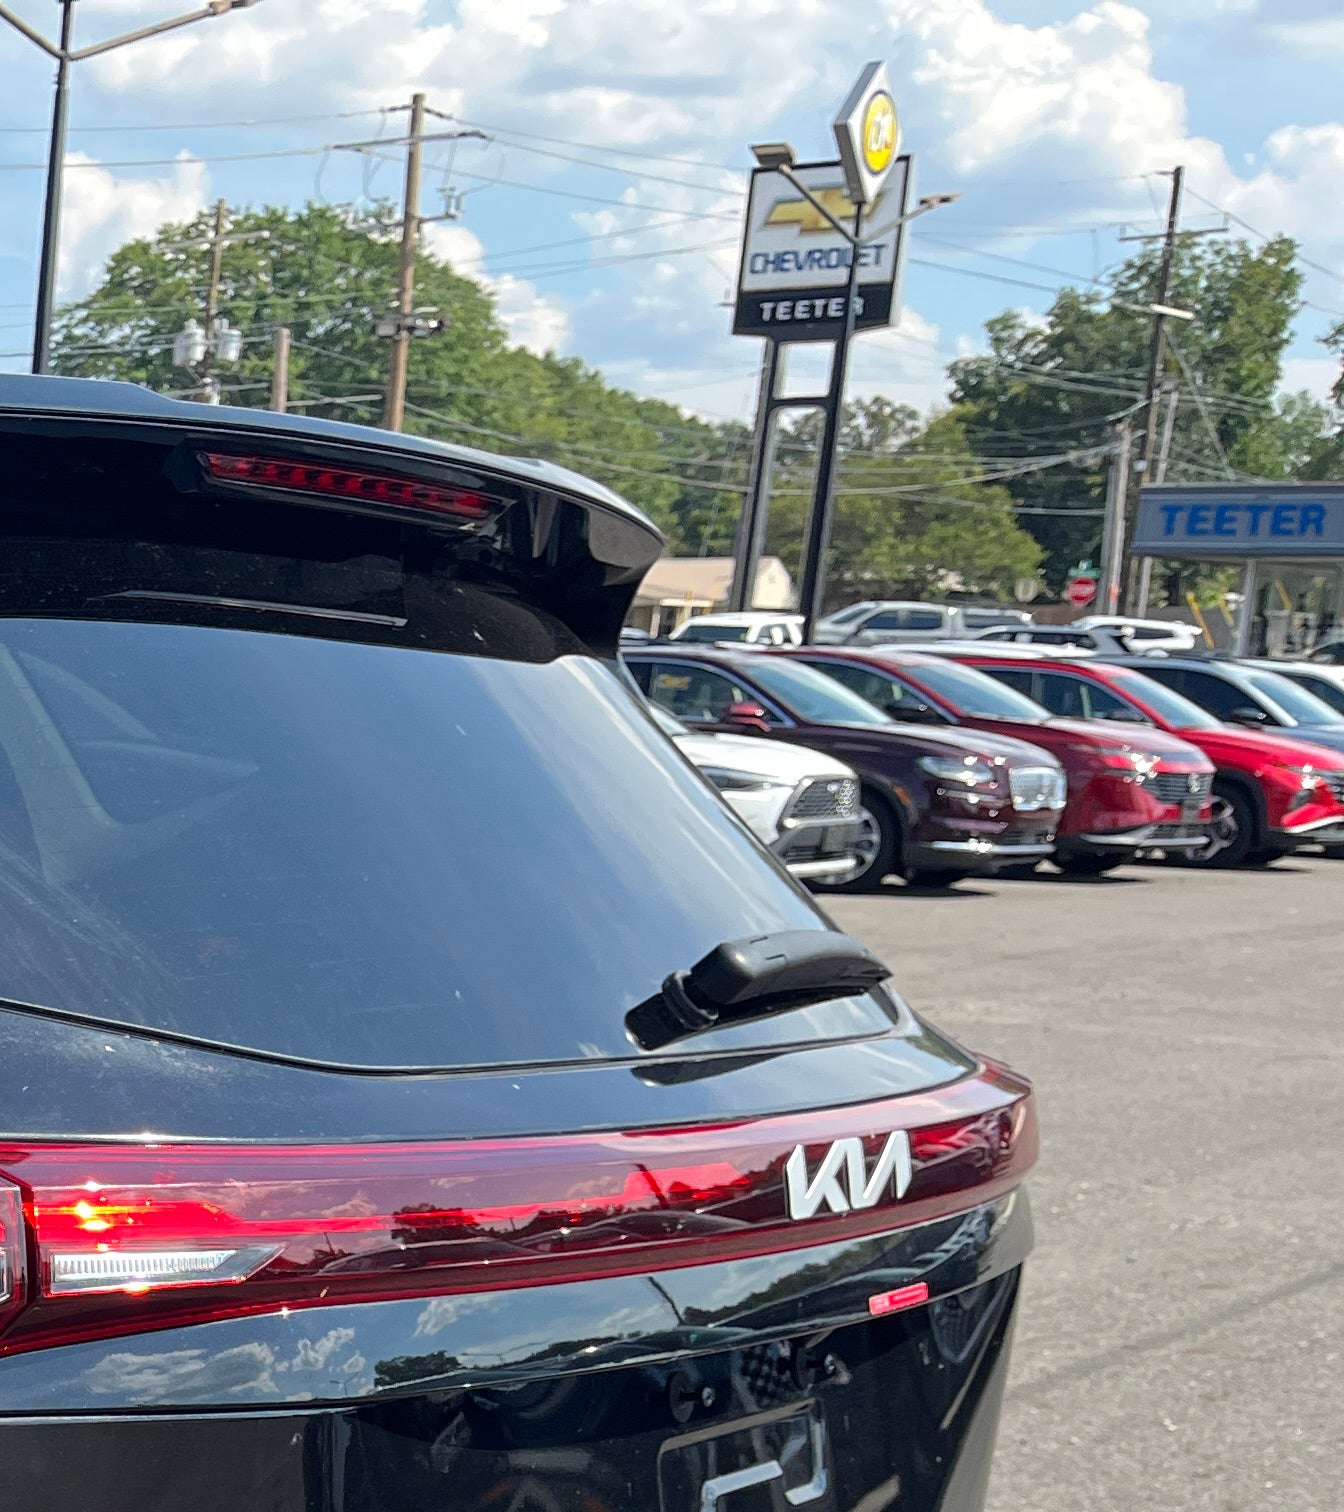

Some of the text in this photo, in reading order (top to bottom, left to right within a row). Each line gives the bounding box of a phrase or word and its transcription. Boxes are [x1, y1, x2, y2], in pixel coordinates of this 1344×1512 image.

[749, 244, 888, 274] CHEVROLET
[1160, 503, 1327, 536] TEETER
[785, 1130, 912, 1220] KIA
